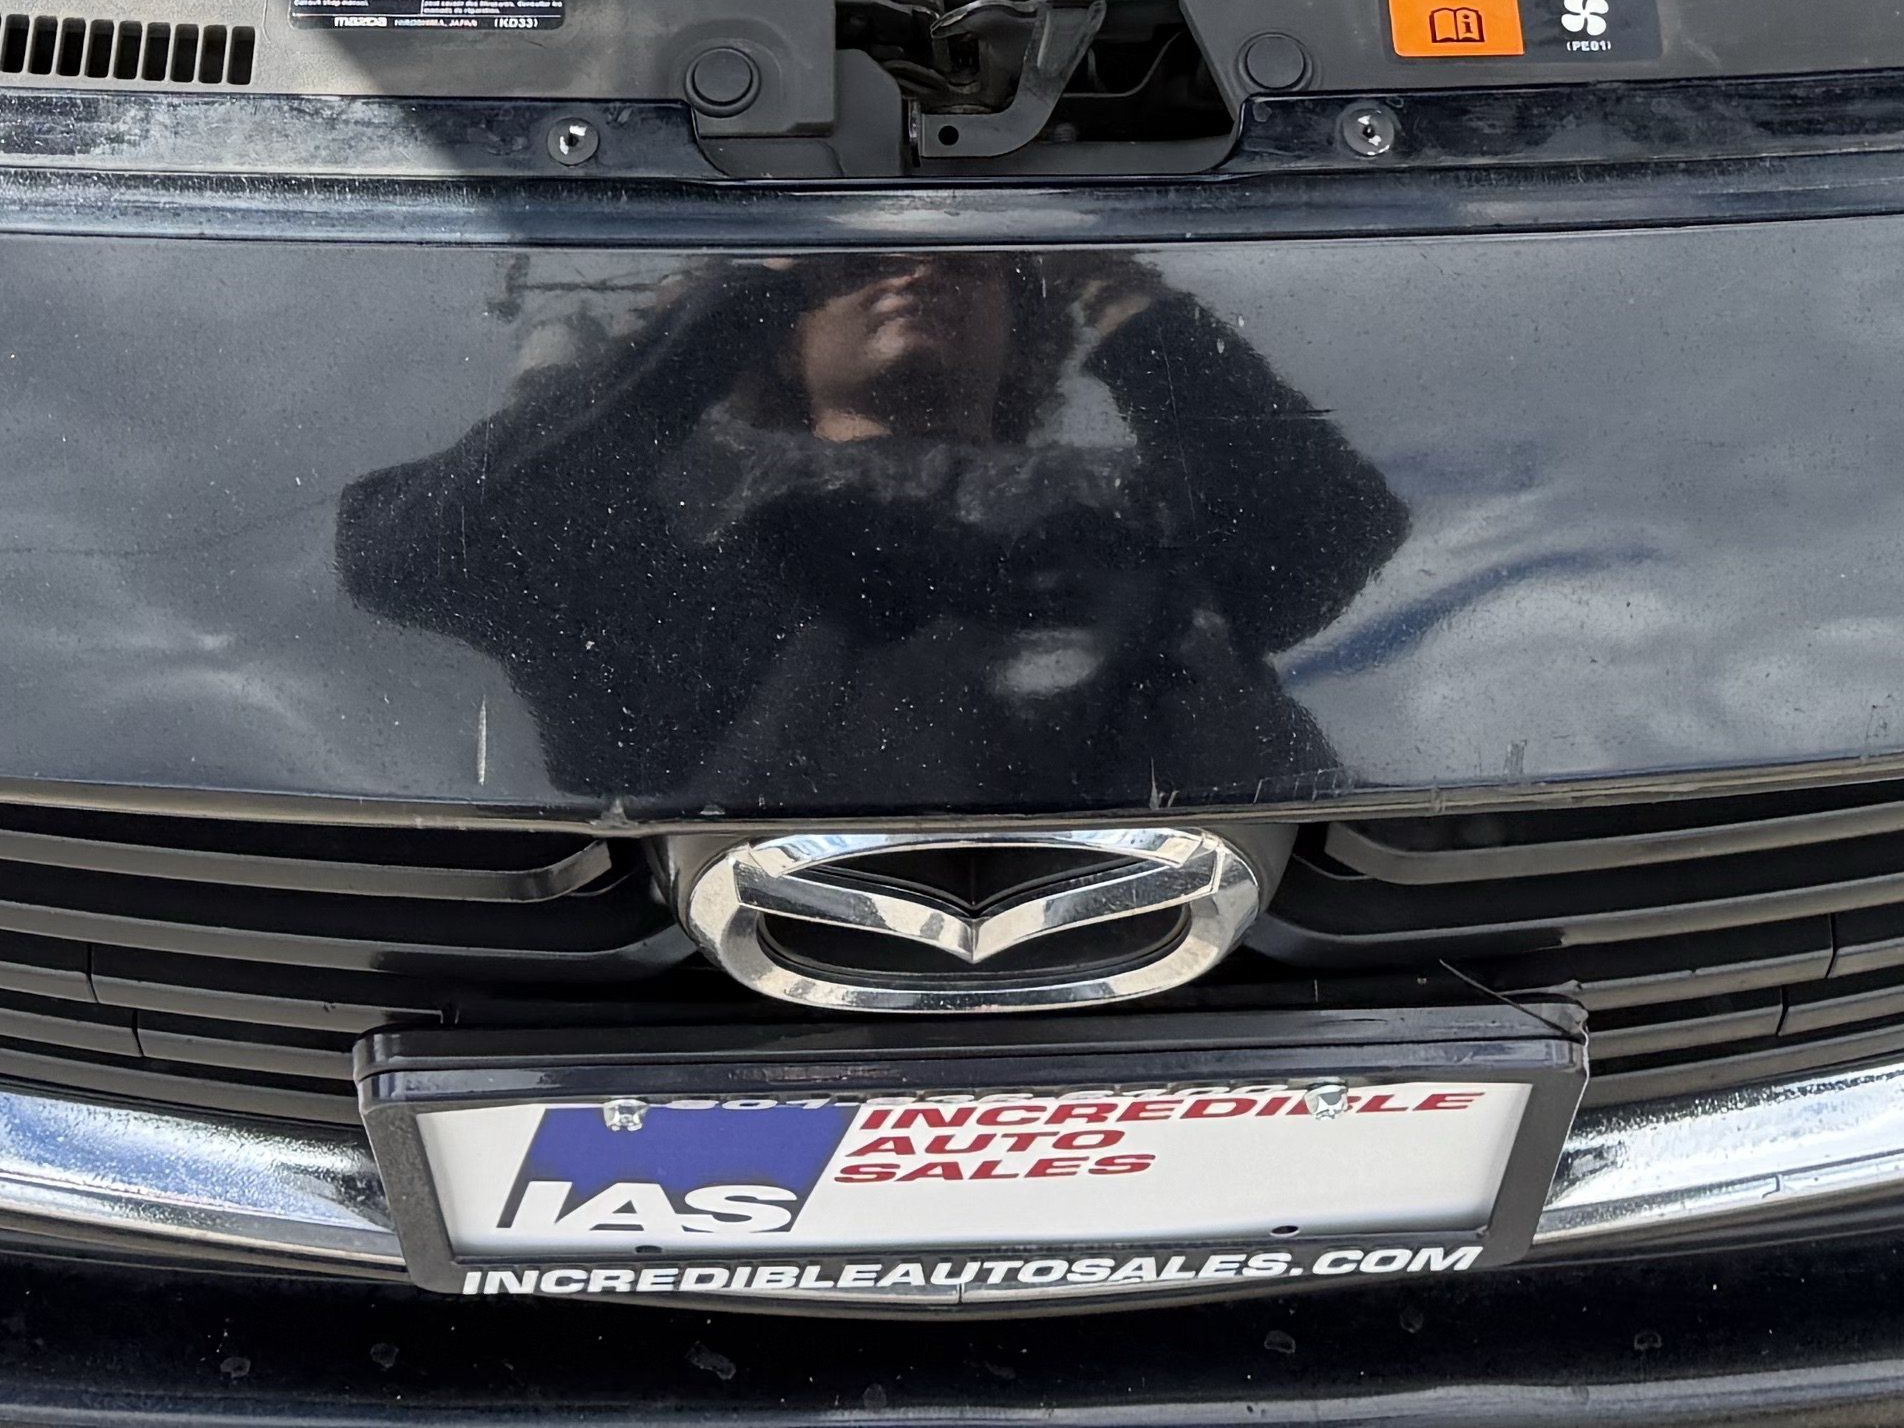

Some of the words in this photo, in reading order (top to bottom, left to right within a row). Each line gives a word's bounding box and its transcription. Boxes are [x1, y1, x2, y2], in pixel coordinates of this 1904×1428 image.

[845, 1130, 1125, 1157] AUTO
[834, 1154, 1156, 1184] SALES
[509, 1181, 798, 1233] IAS
[462, 1245, 1484, 1295] INCREDIBLEAUTOSALES.COM
